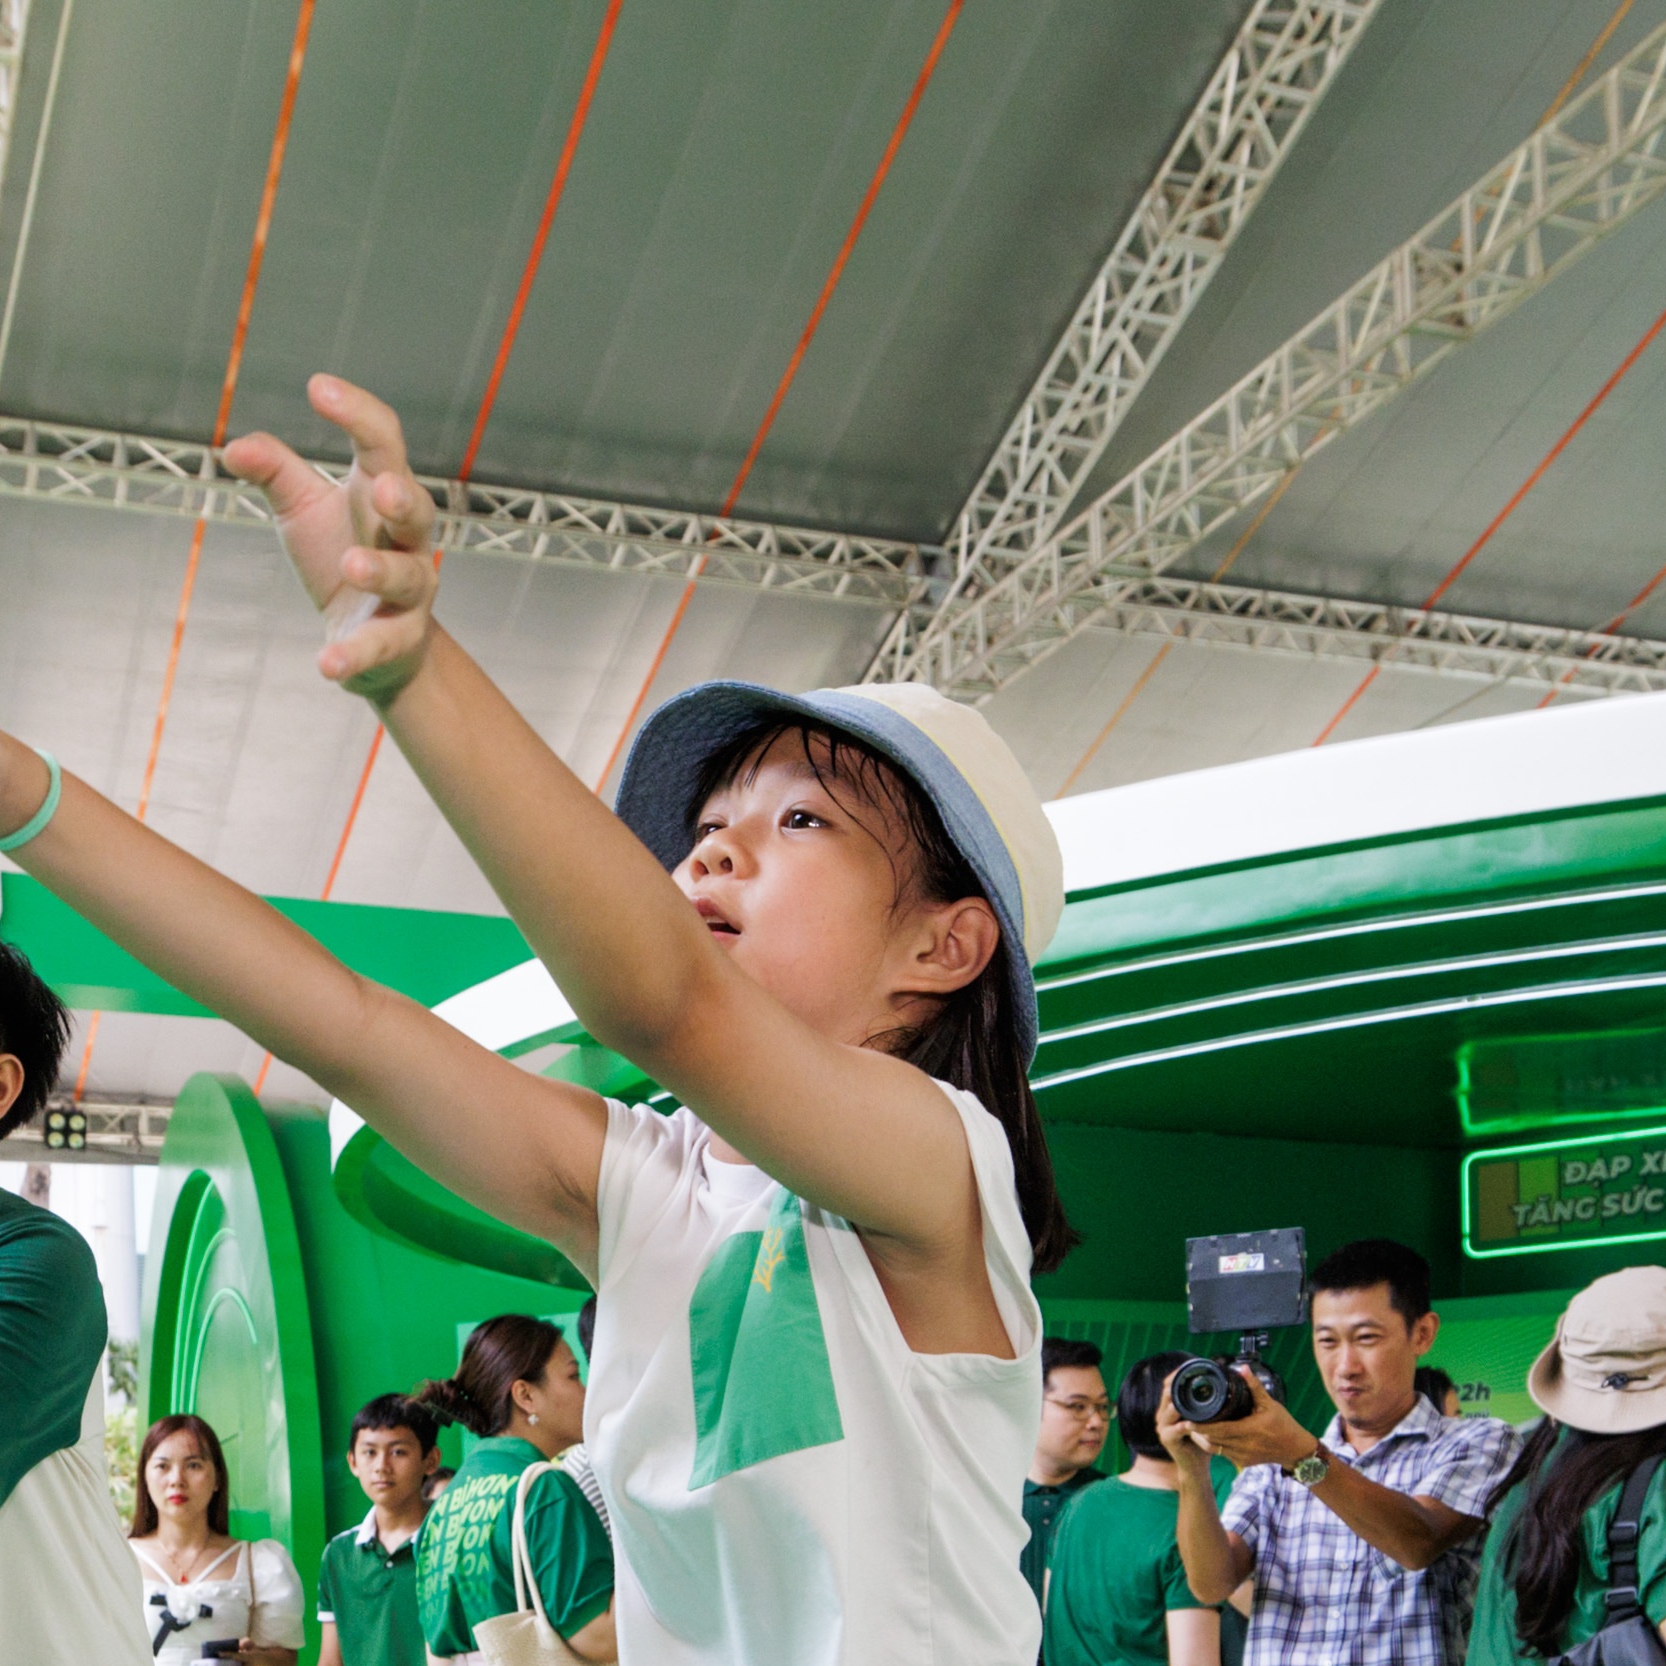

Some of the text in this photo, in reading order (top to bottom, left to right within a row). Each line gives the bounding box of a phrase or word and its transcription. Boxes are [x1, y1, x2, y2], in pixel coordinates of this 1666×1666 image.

[1564, 1154, 1632, 1188] ĐẠP
[1513, 1195, 1597, 1228] TĂNG
[1602, 1184, 1666, 1218] SỨC
